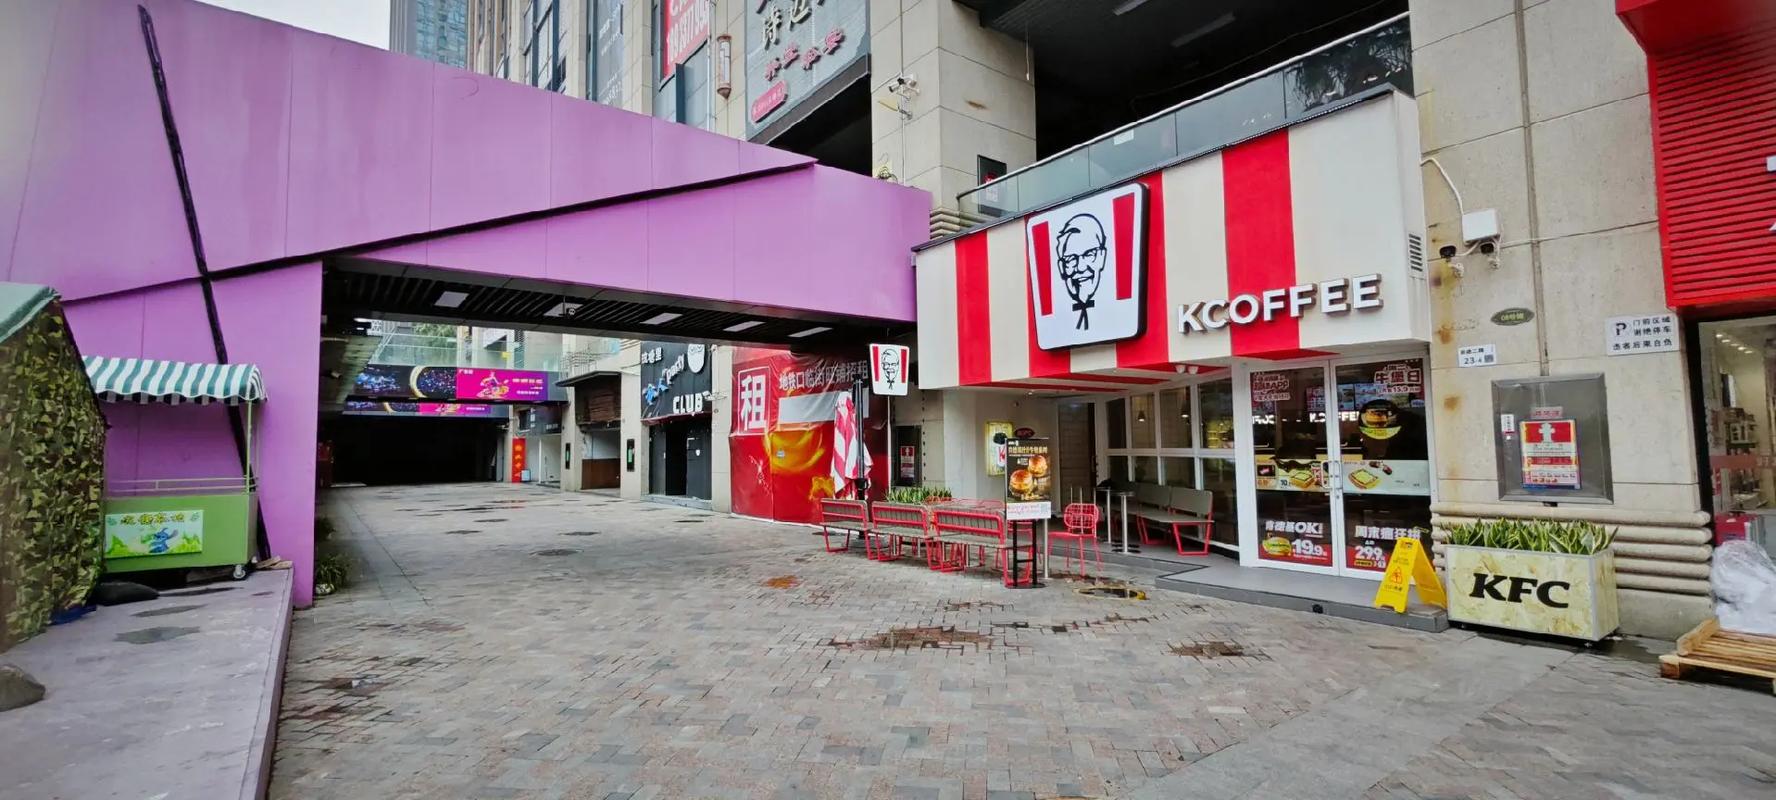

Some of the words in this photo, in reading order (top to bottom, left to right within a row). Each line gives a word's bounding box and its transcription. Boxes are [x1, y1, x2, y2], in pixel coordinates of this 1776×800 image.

[1178, 274, 1384, 334] KCOFFEE
[672, 391, 704, 415] CLUB
[741, 374, 766, 431] 租
[1469, 572, 1570, 609] KFC
